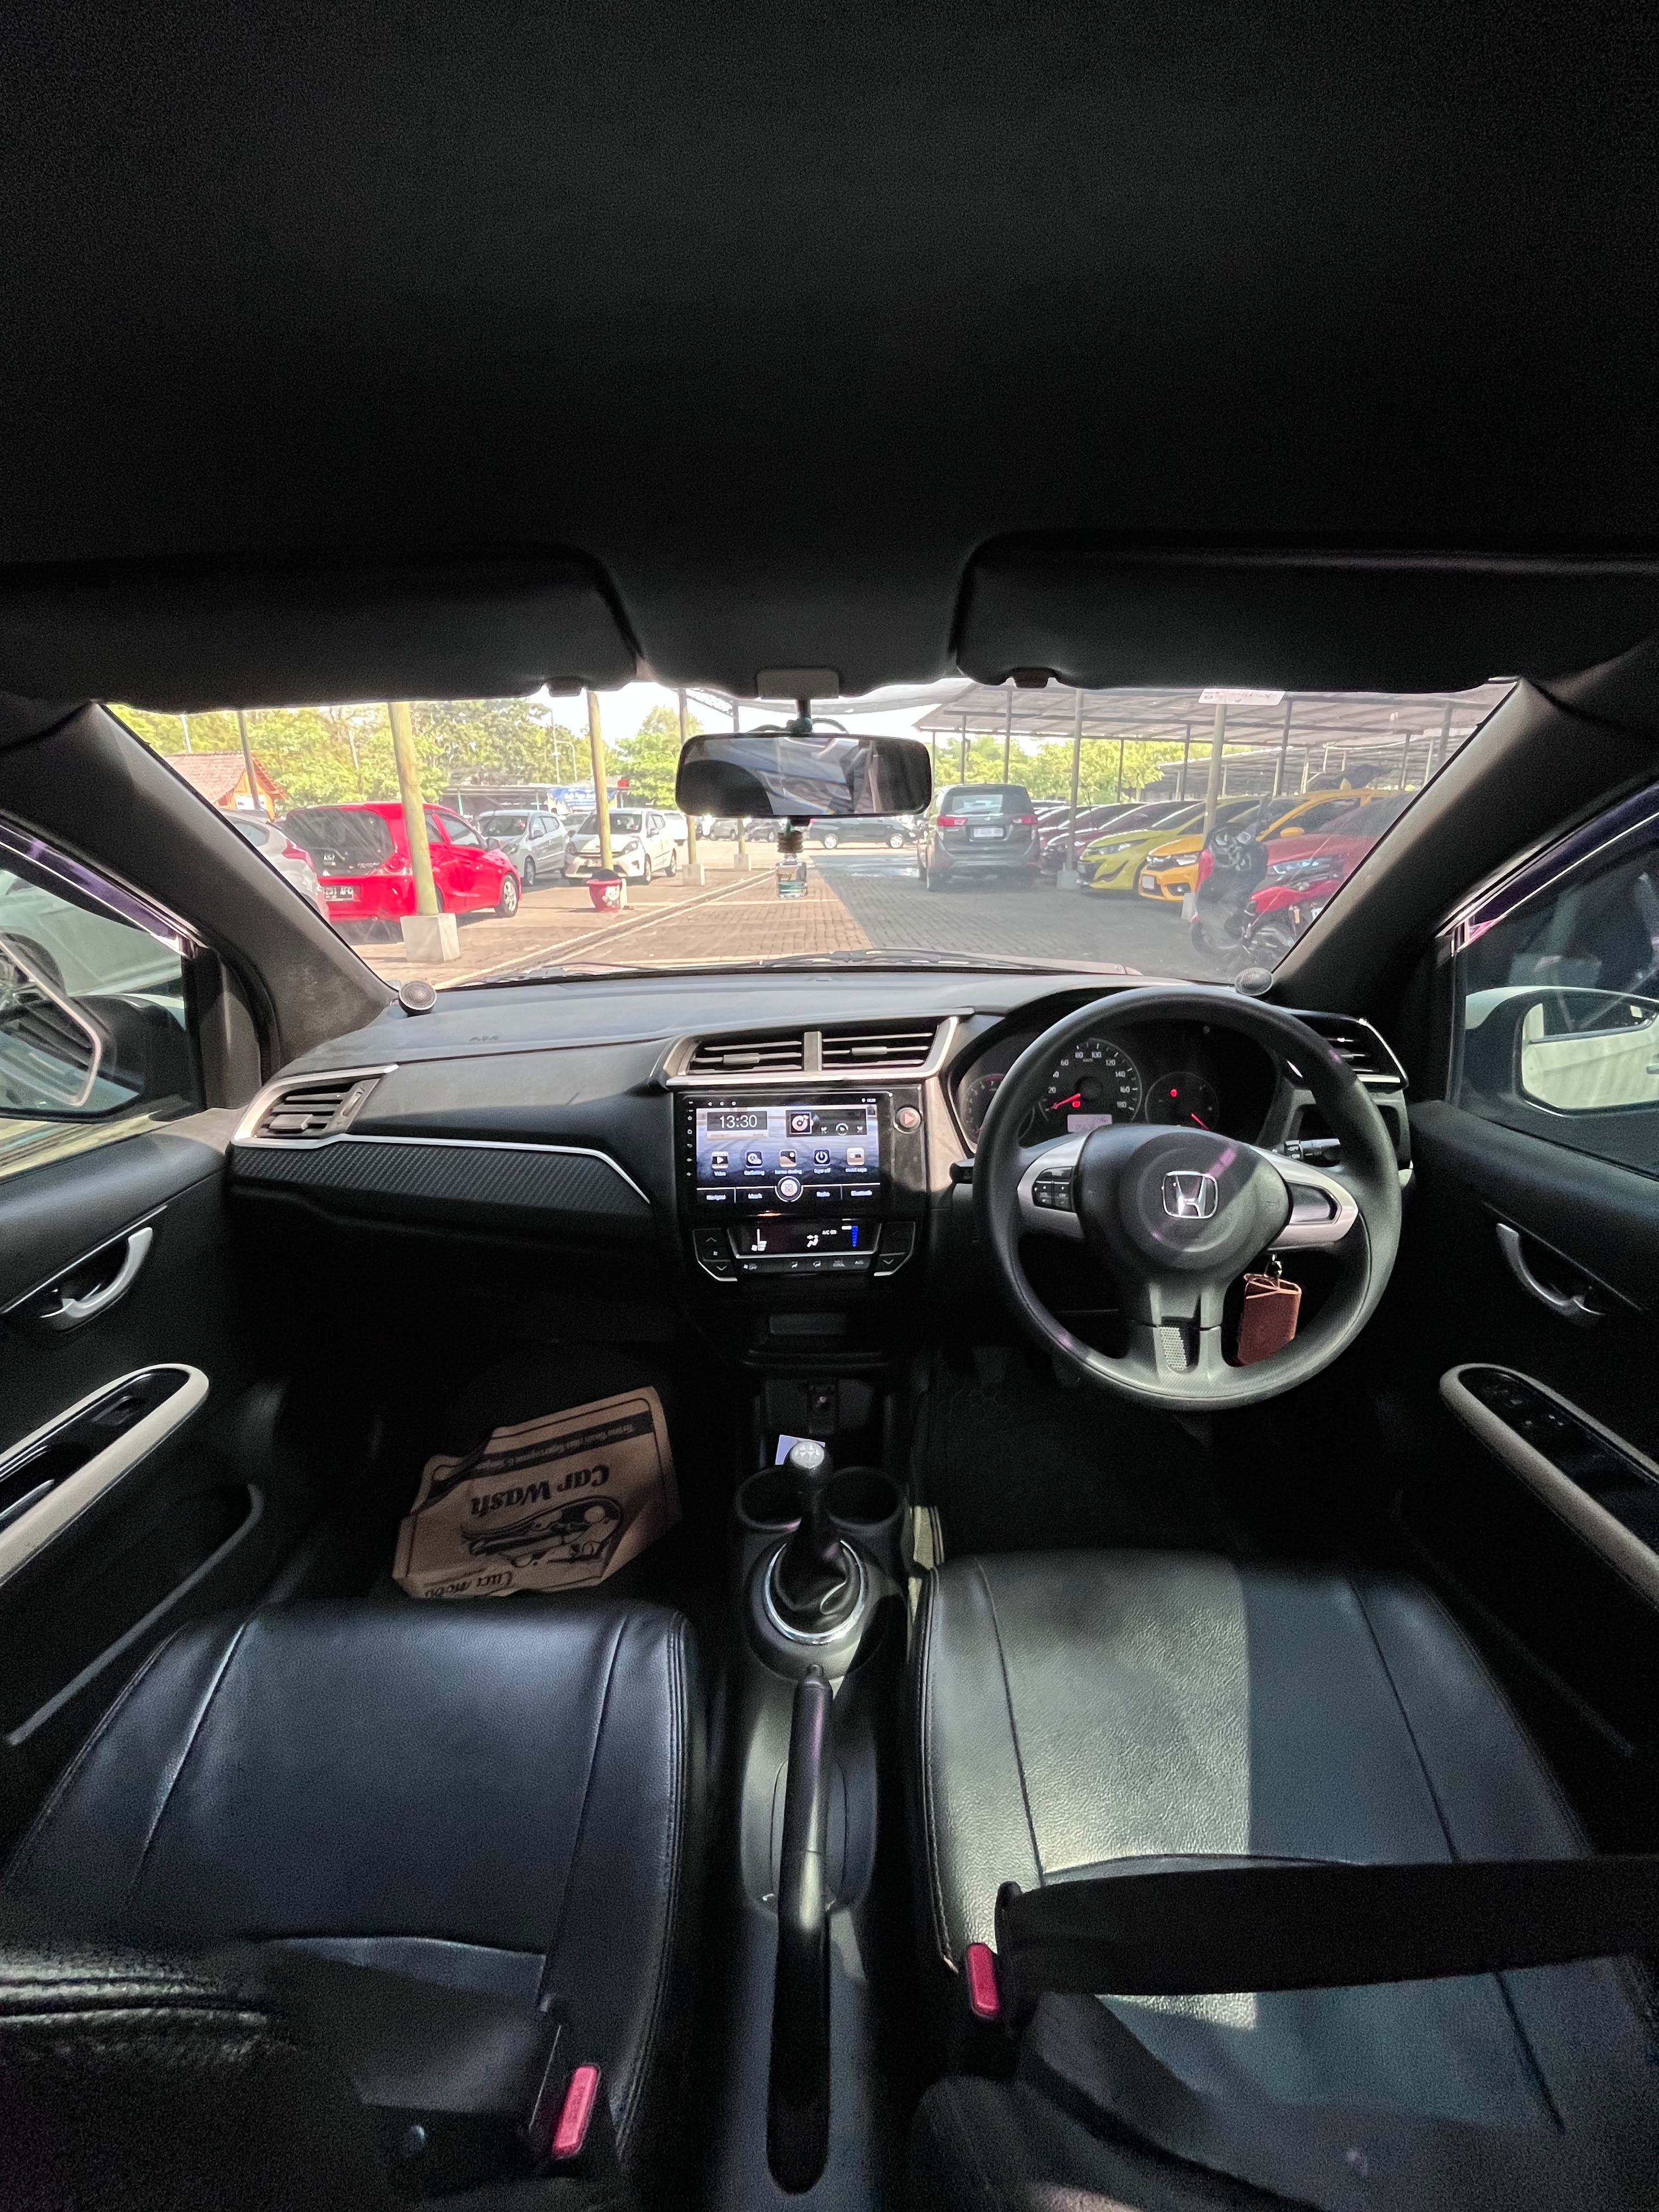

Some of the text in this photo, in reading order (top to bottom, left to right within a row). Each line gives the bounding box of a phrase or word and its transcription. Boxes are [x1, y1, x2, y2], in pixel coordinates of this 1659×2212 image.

[719, 1114, 758, 1128] 13:30
[471, 1465, 609, 1518] Car Wash
[476, 1571, 512, 1587] Cuci
